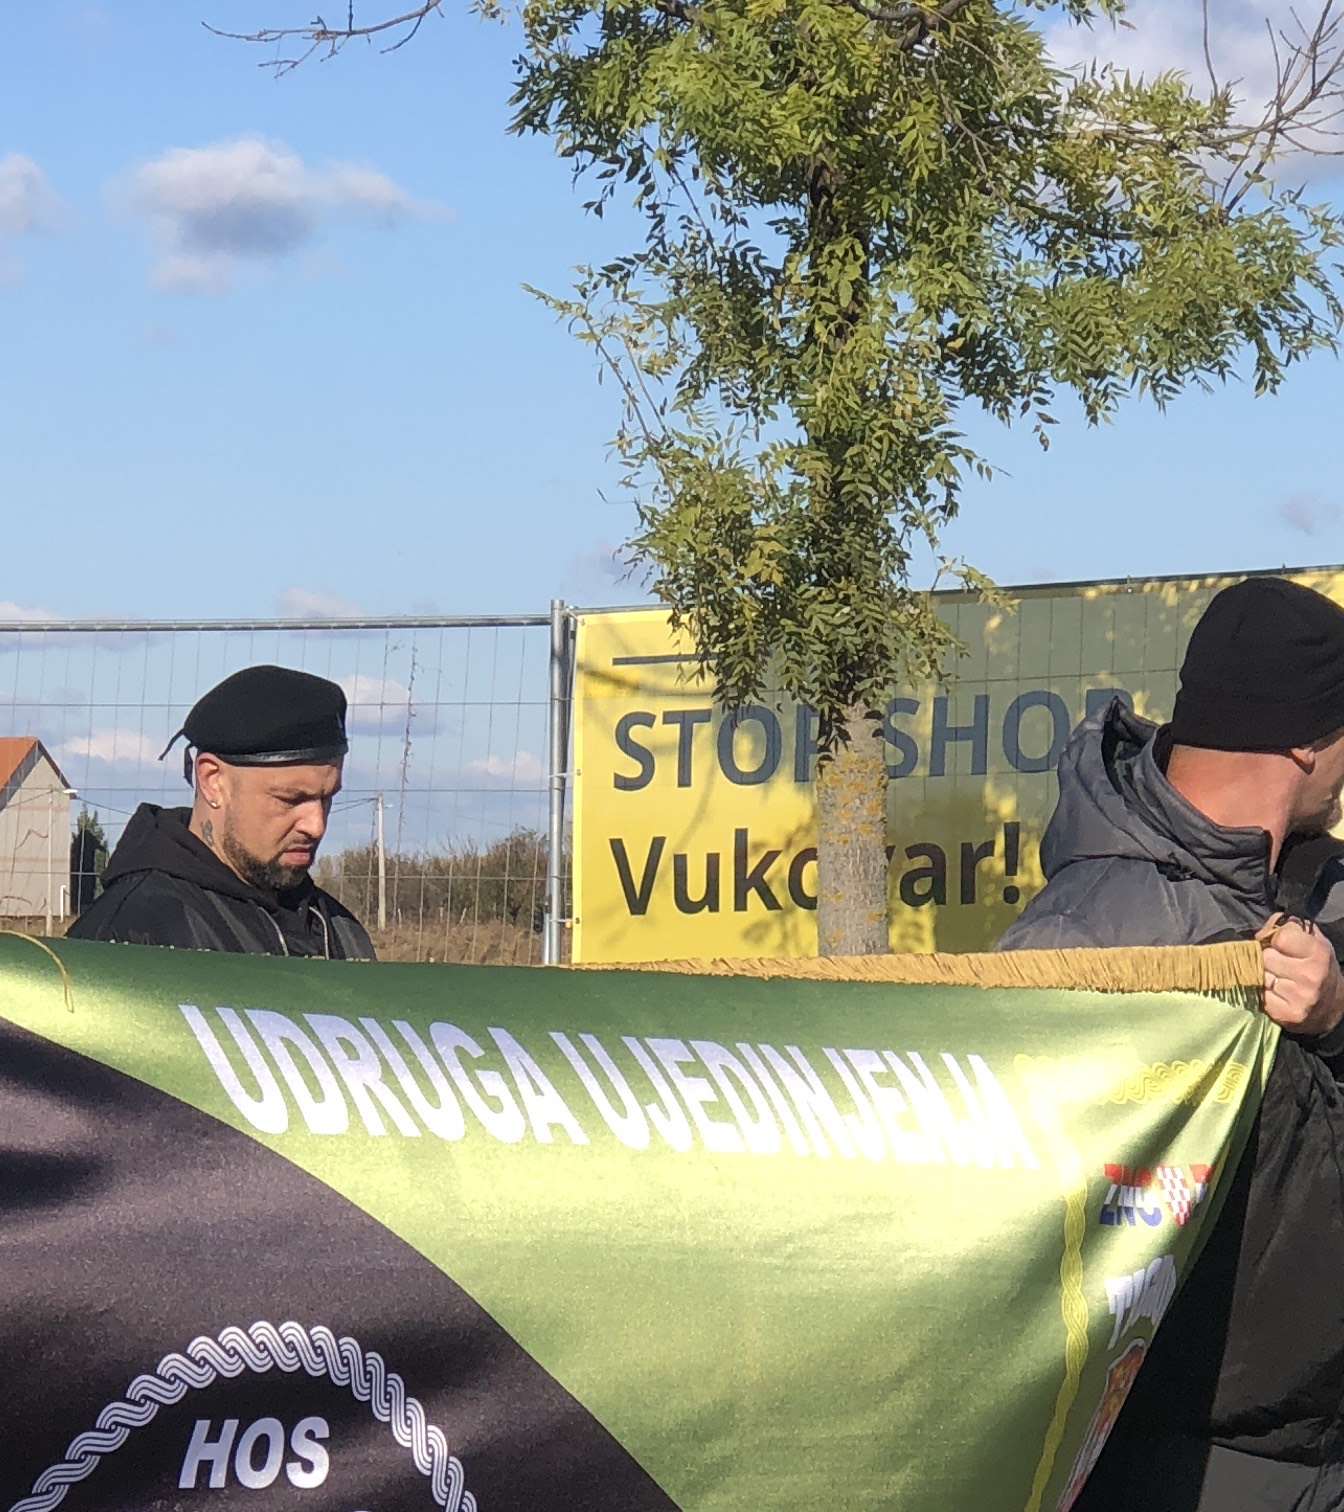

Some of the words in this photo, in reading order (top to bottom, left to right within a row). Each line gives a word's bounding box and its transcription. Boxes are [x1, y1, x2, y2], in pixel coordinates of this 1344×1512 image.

[179, 1003, 591, 1146] UDRUGA
[579, 1032, 1040, 1170] UJEDINJENJA
[177, 1417, 330, 1490] HOS
